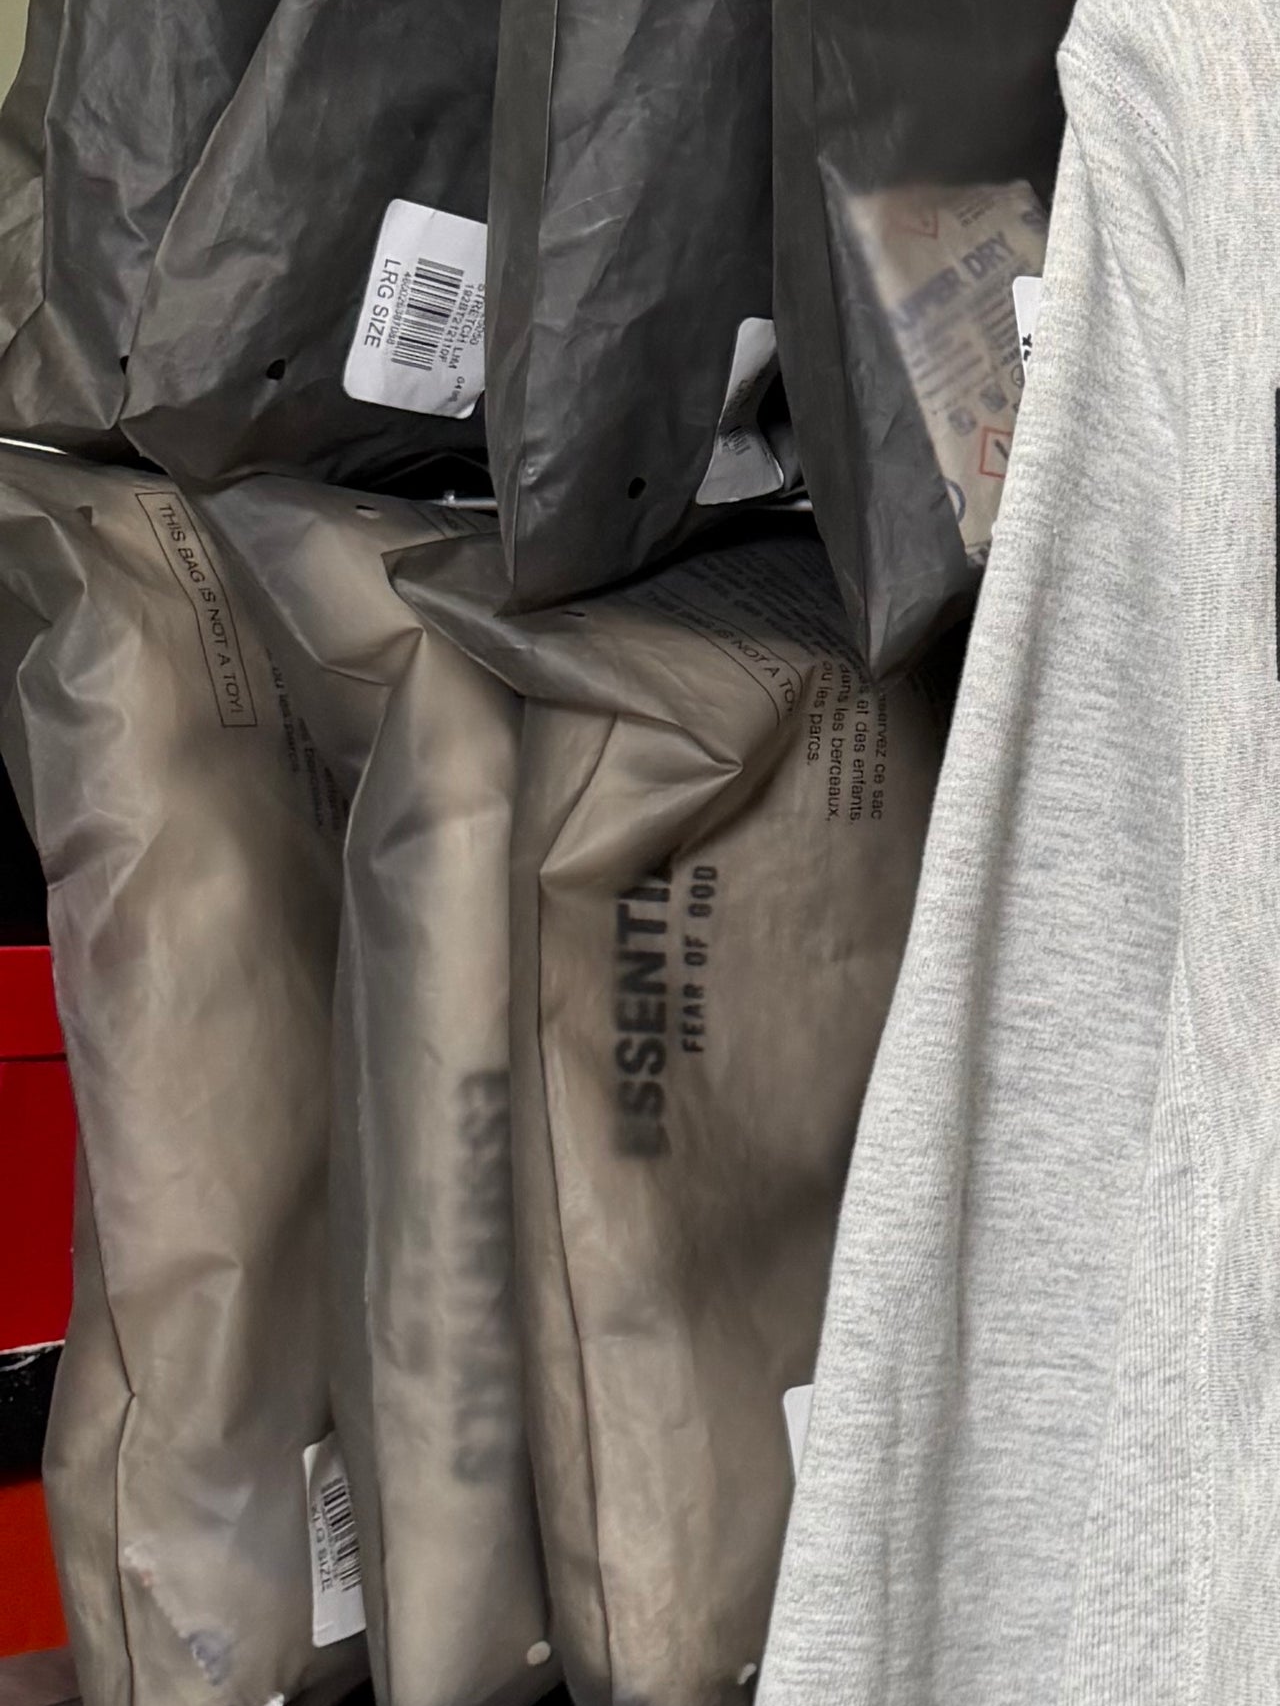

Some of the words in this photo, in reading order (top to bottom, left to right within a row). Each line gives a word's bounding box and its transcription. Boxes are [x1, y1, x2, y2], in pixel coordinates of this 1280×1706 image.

[961, 230, 1015, 280] DRY
[376, 257, 402, 301] LRG
[363, 303, 389, 350] SIZE
[159, 502, 187, 544] THIS
[176, 547, 207, 585] BAG
[198, 586, 217, 604] IS
[207, 606, 232, 650] NOT
[217, 652, 232, 667] A
[734, 638, 770, 667] NOT
[768, 666, 781, 679] A
[806, 712, 825, 766] parcs.
[832, 707, 849, 733] les
[854, 720, 871, 752] des
[825, 736, 844, 823] berceaux,
[873, 760, 888, 784] ce
[870, 787, 887, 821] sac
[687, 864, 720, 920] GOD
[681, 932, 710, 967] OF
[680, 983, 706, 1055] FEAR
